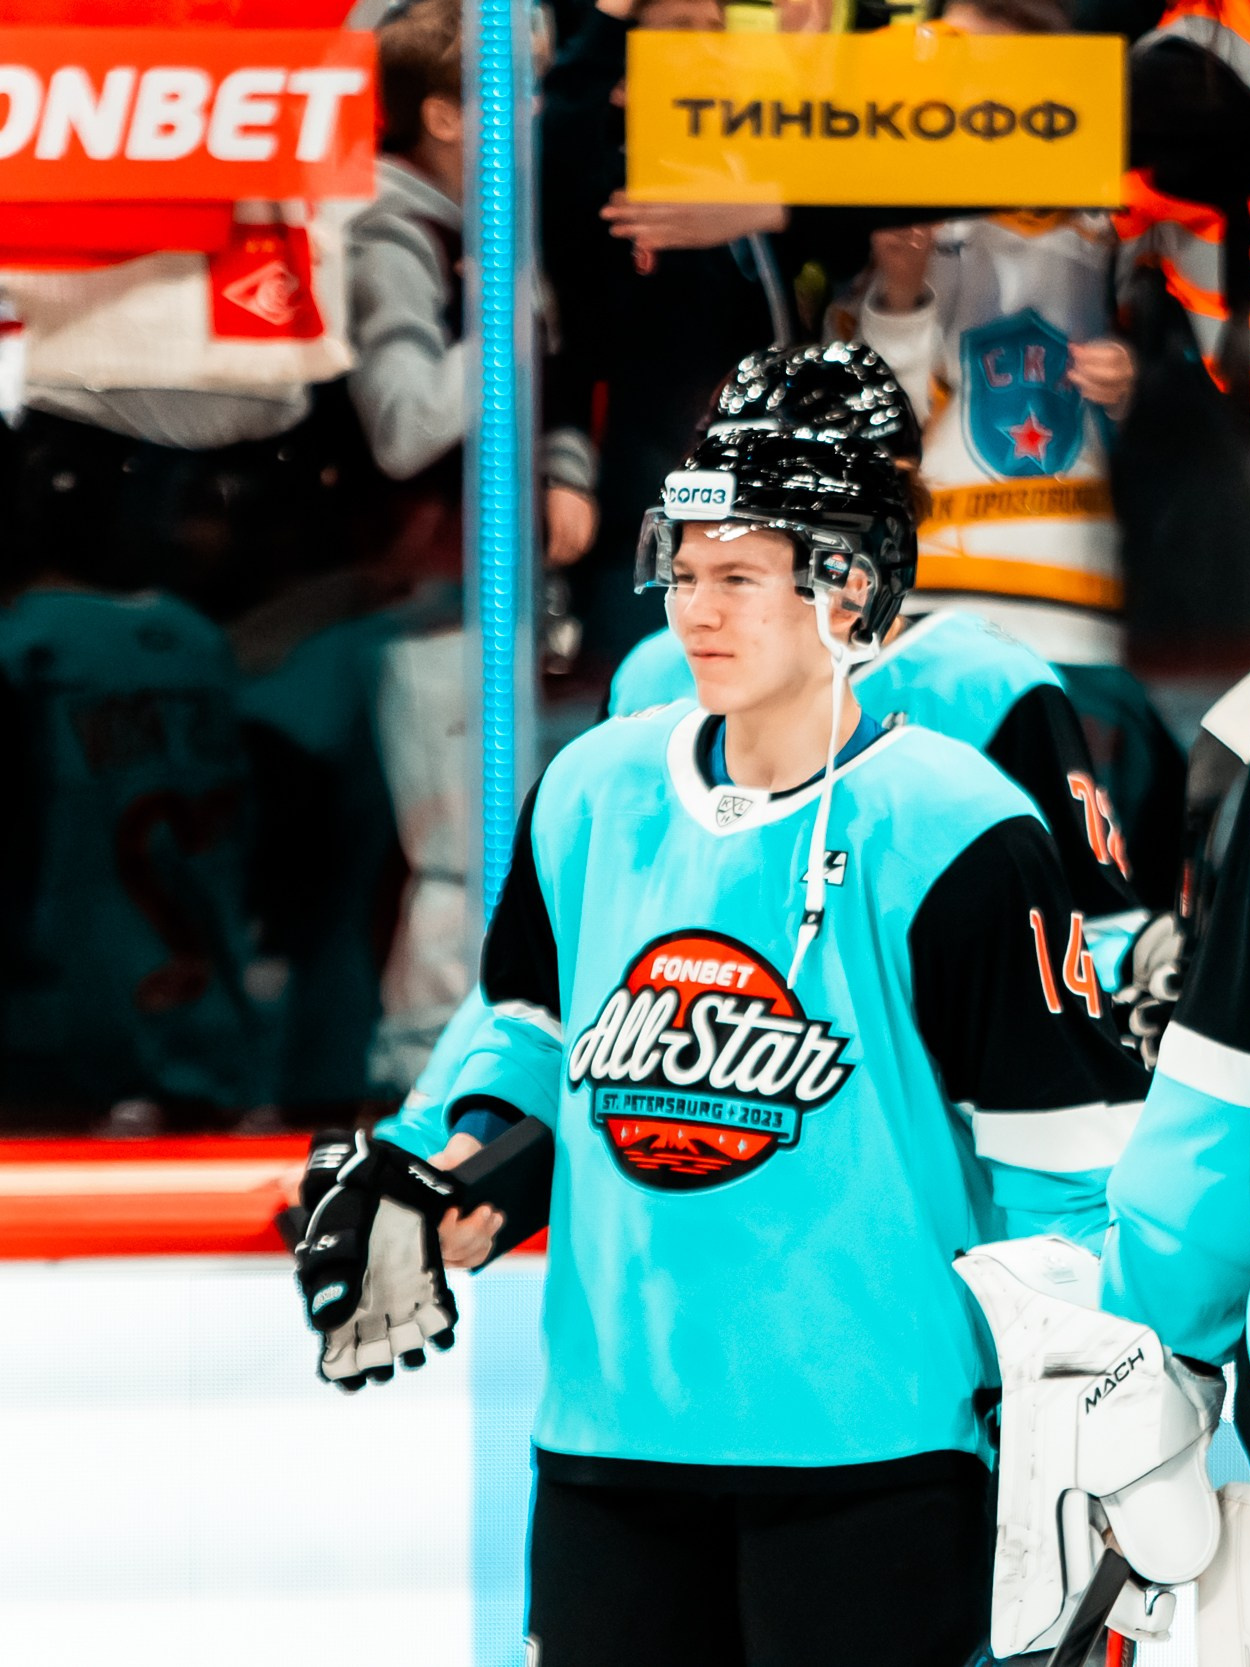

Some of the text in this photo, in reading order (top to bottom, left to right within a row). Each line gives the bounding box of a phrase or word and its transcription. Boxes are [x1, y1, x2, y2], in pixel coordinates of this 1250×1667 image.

[674, 97, 1079, 142] ТИНЬКОФФ
[650, 955, 755, 988] FONBET
[1029, 908, 1101, 1018] 14
[569, 987, 844, 1101] All-Star
[602, 1093, 783, 1129] ST. PETERSBURG 2023
[1084, 1347, 1145, 1415] MACH
